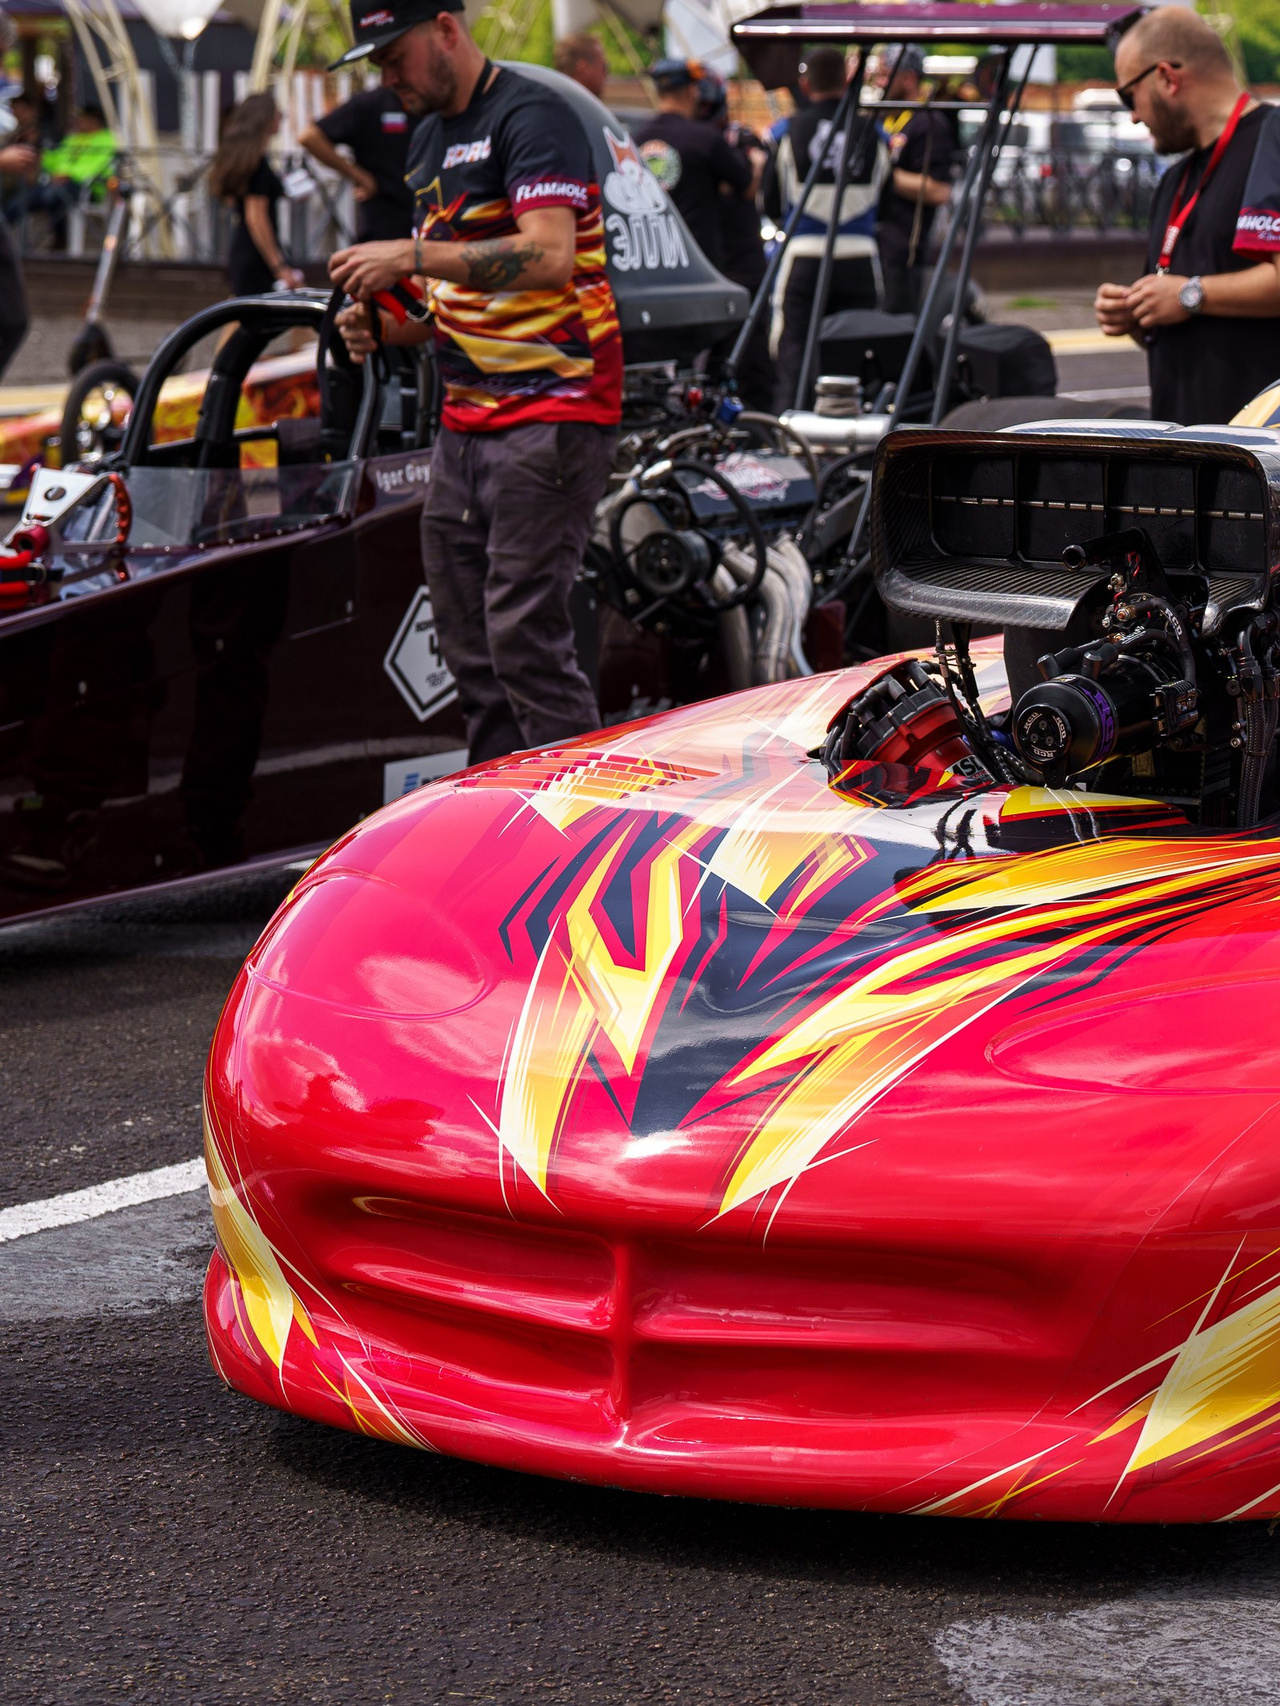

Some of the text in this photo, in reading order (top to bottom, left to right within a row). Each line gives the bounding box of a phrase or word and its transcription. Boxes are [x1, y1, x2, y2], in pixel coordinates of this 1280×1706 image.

[1164, 608, 1183, 637] RCD
[1023, 711, 1039, 731] RCD
[1056, 716, 1067, 739] RCD
[1033, 748, 1054, 758] RCD
